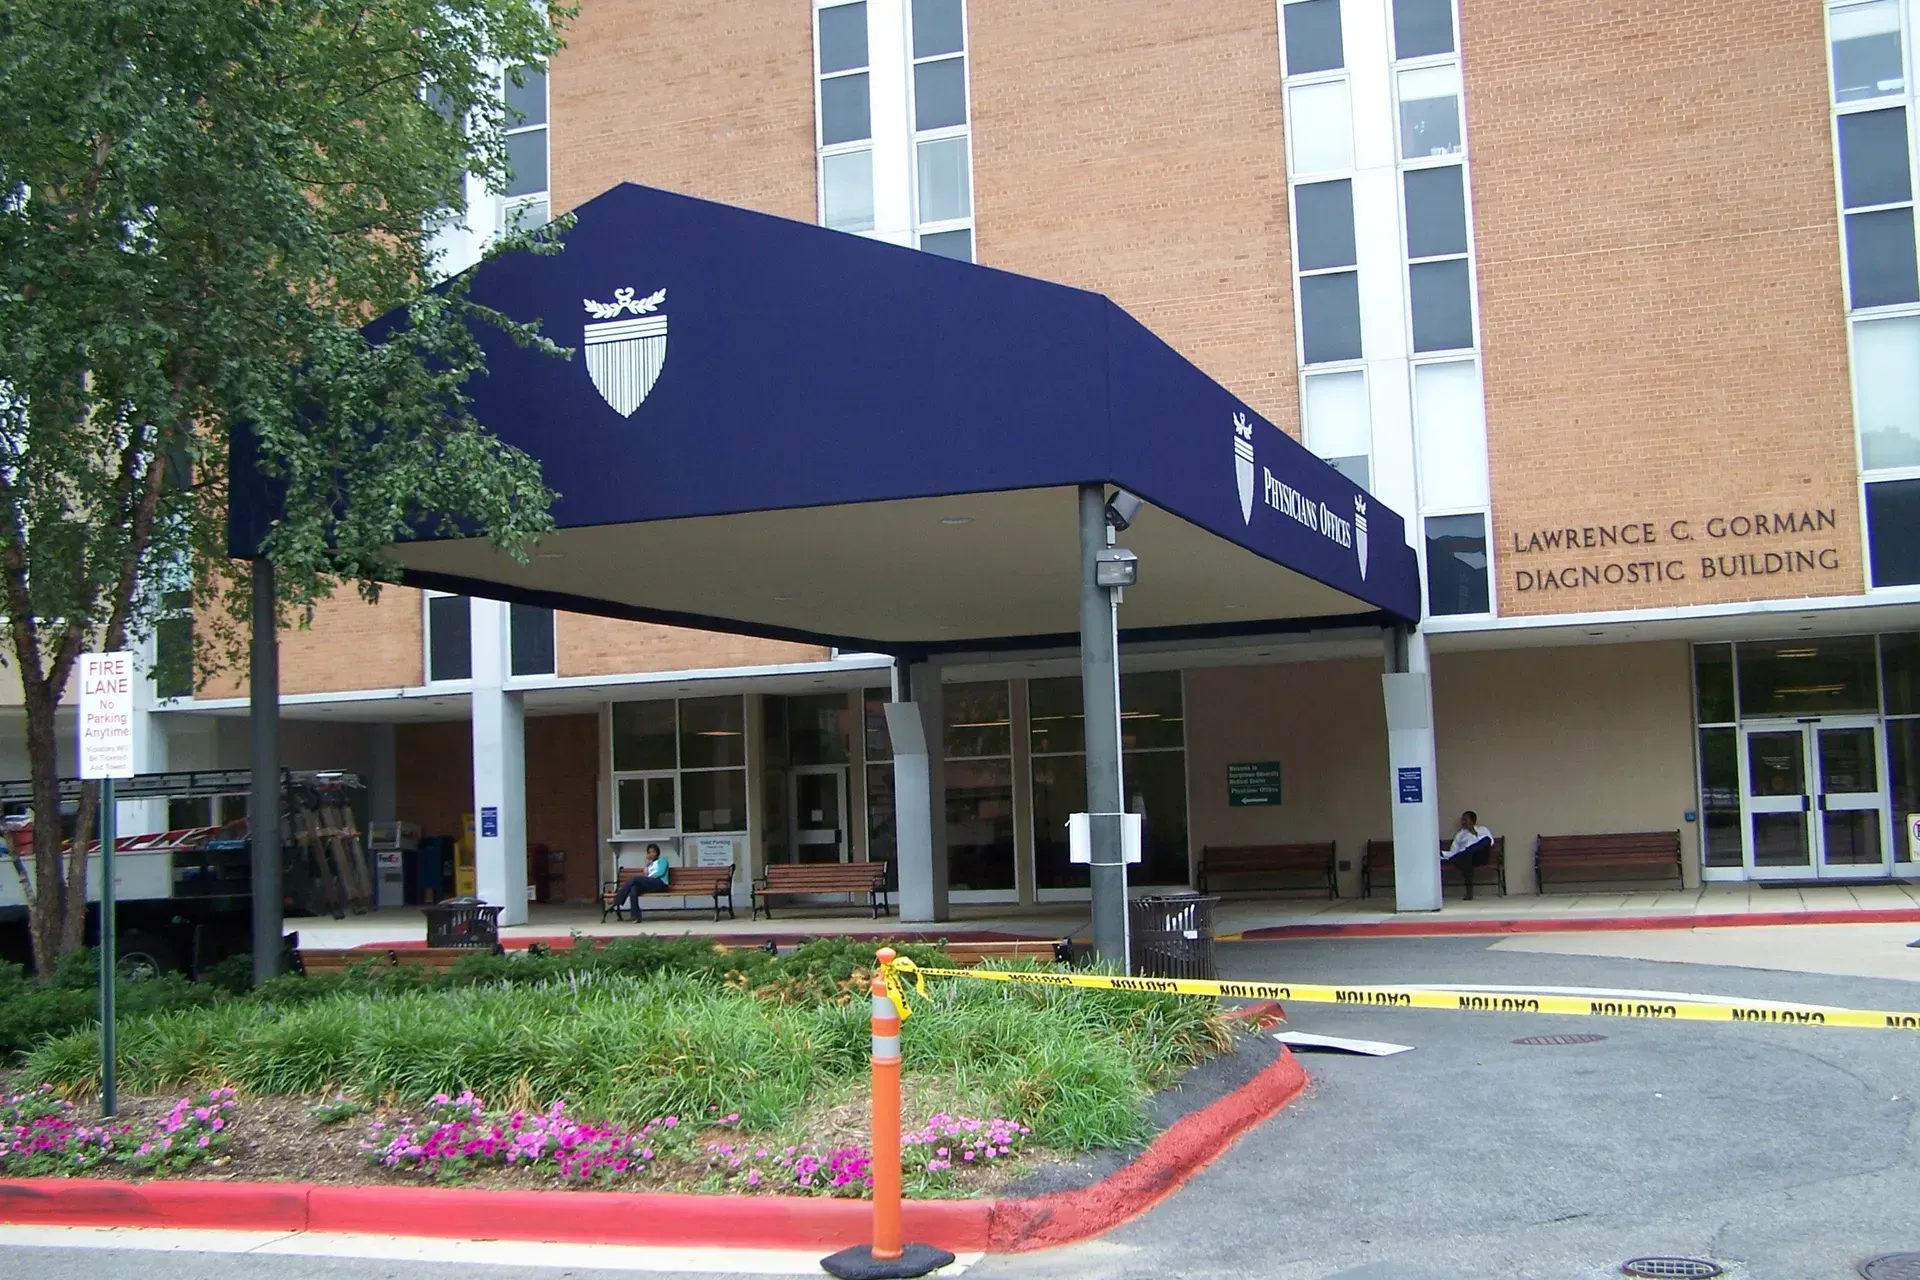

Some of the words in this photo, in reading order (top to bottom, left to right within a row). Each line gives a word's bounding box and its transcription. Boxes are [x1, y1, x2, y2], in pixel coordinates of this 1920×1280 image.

[1263, 466, 1318, 532] PHYSICIANS
[1319, 501, 1351, 549] OFFICES
[1513, 522, 1656, 553] LAWRENCE
[1670, 520, 1694, 541] C.
[1706, 508, 1836, 539] GORMAN
[1515, 560, 1685, 592] DIAGNOSTIC
[1700, 548, 1839, 579] BUILDING
[89, 660, 125, 676] FIRE
[85, 678, 128, 695] LANE
[99, 699, 115, 710] No
[87, 713, 127, 725] Parking
[84, 727, 130, 740] Anytime
[1110, 979, 1178, 992] CAUTION
[1219, 984, 1291, 998] CAUTION
[1335, 990, 1411, 1006] CAUTION
[1459, 996, 1539, 1012] CAUTION
[1590, 1002, 1677, 1018] CAUTION
[1731, 1008, 1825, 1024] CAUTION
